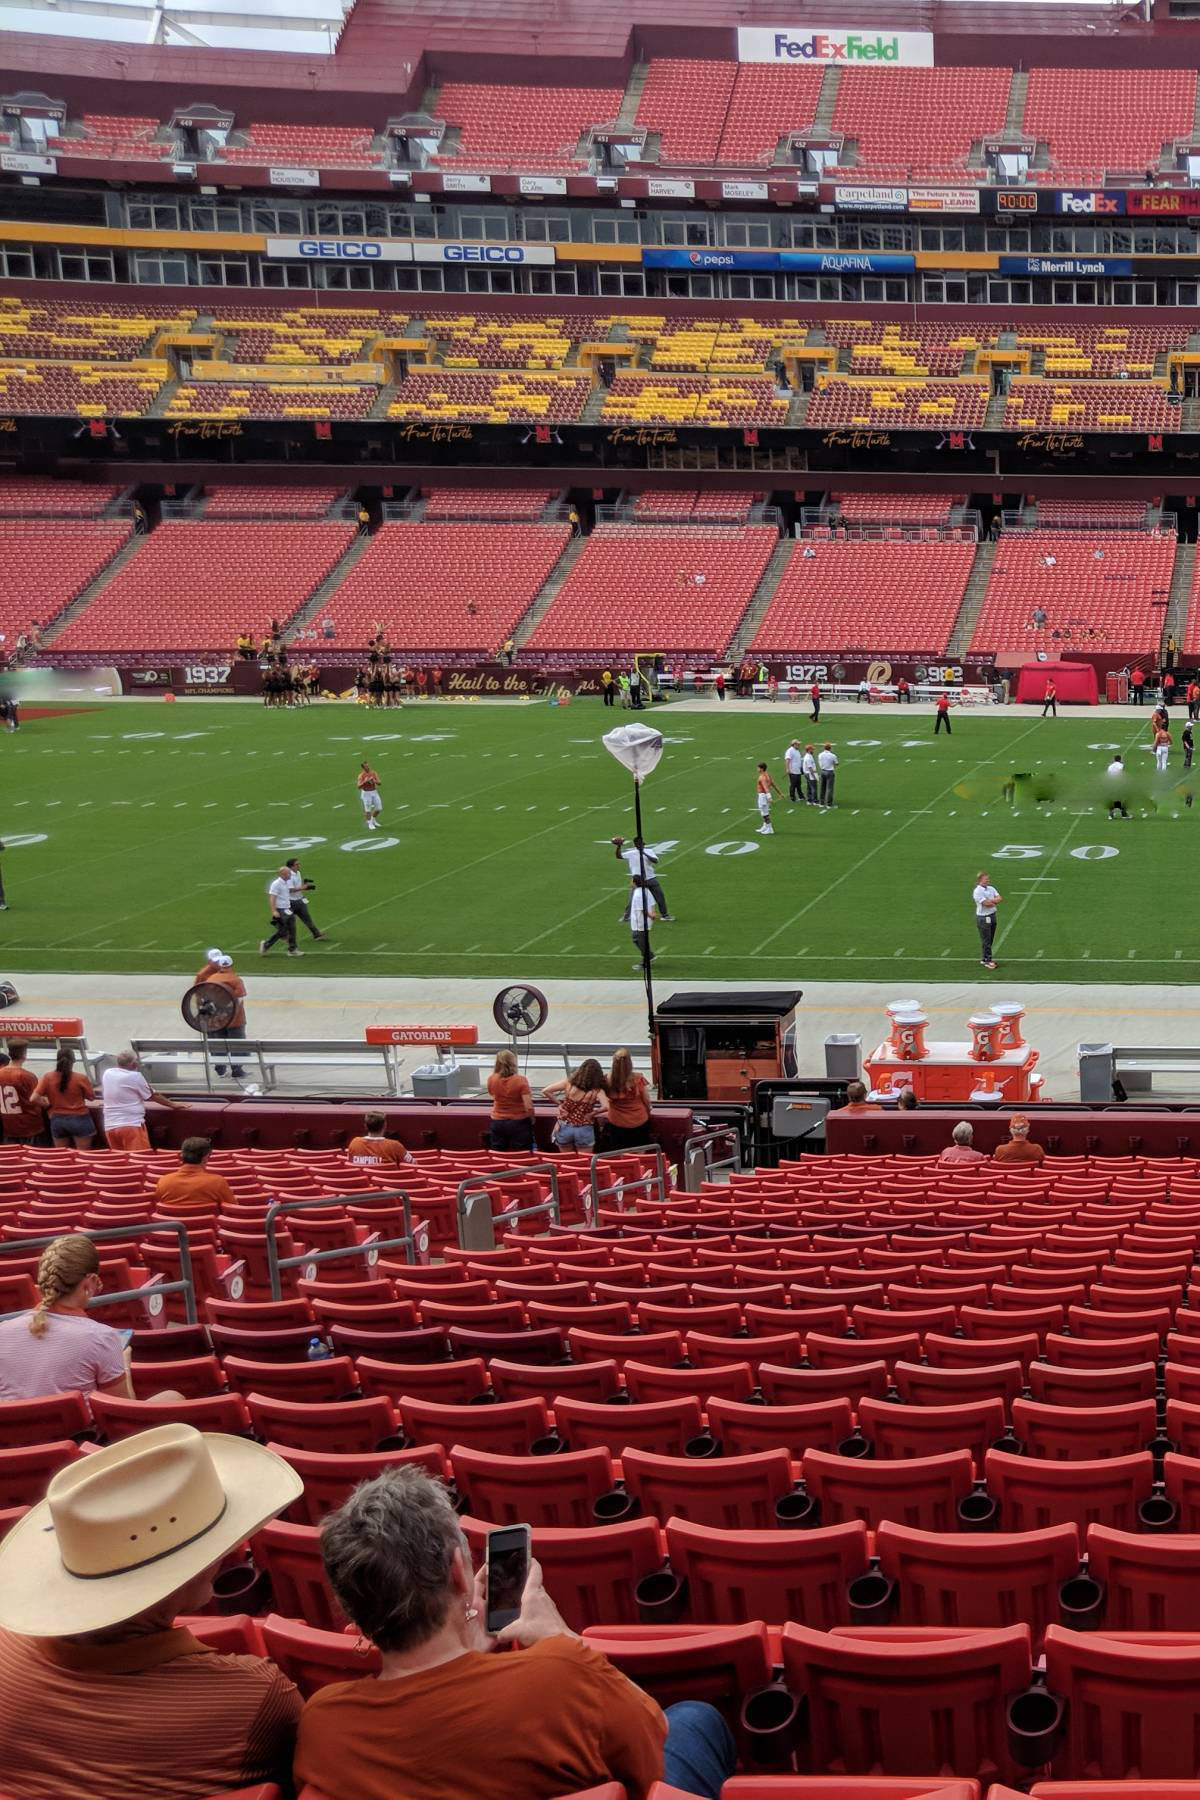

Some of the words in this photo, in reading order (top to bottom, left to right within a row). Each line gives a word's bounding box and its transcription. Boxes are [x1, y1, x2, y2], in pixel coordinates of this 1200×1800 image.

[775, 34, 898, 60] FedExField
[1062, 192, 1118, 212] FedEx
[299, 242, 382, 257] GEICO
[444, 245, 524, 262] GEICO
[704, 255, 734, 265] pepsi
[821, 255, 872, 270] AQUAFINA
[1041, 261, 1074, 272] Merrill
[1076, 262, 1104, 274] Lynch
[185, 666, 231, 683] 1937
[785, 665, 828, 681] 1972
[449, 672, 485, 689] Hail
[486, 676, 500, 689] to
[503, 673, 528, 690] the
[0, 1023, 54, 1032] GATORADE
[392, 1031, 451, 1040] GATORADE
[901, 1030, 914, 1044] G
[977, 1031, 989, 1045] G
